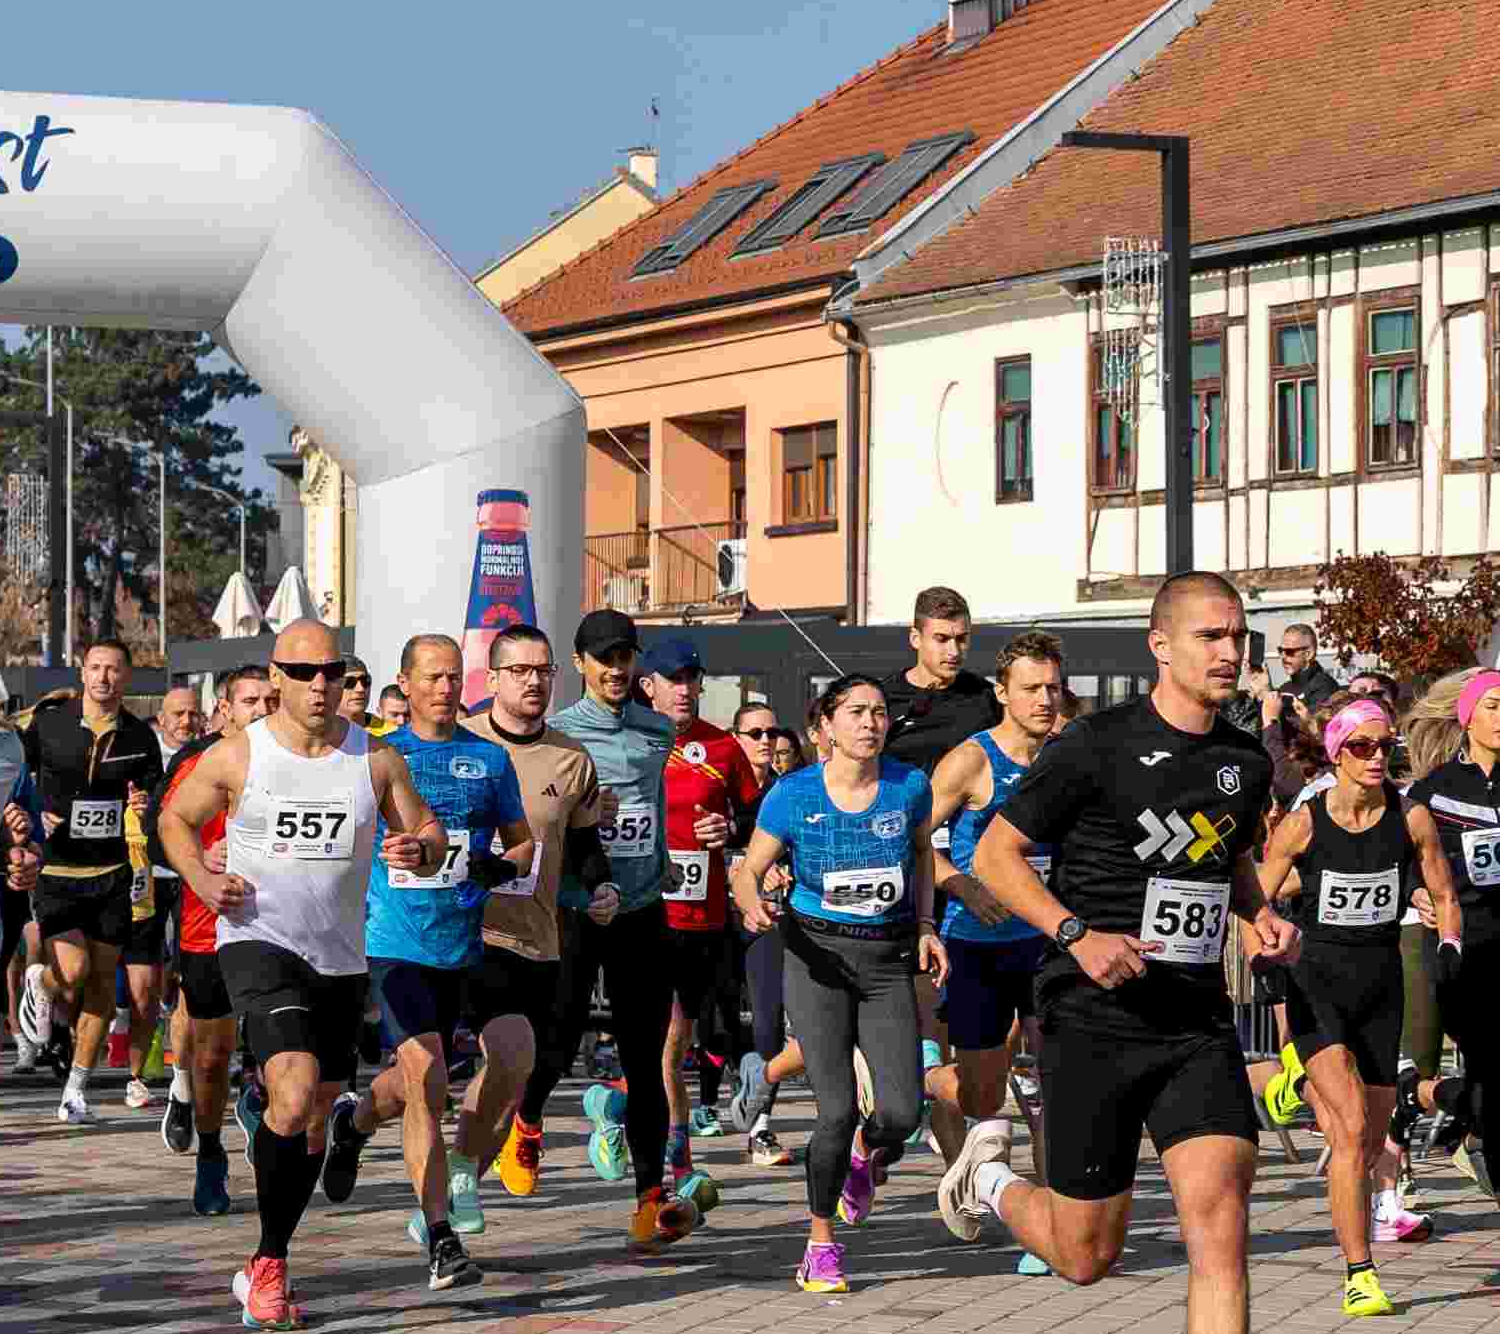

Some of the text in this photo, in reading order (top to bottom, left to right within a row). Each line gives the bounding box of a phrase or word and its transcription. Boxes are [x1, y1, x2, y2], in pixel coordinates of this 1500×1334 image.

[76, 809, 117, 827] 528
[276, 811, 347, 840] 557
[1328, 884, 1392, 910] 578
[1153, 899, 1223, 939] 583
